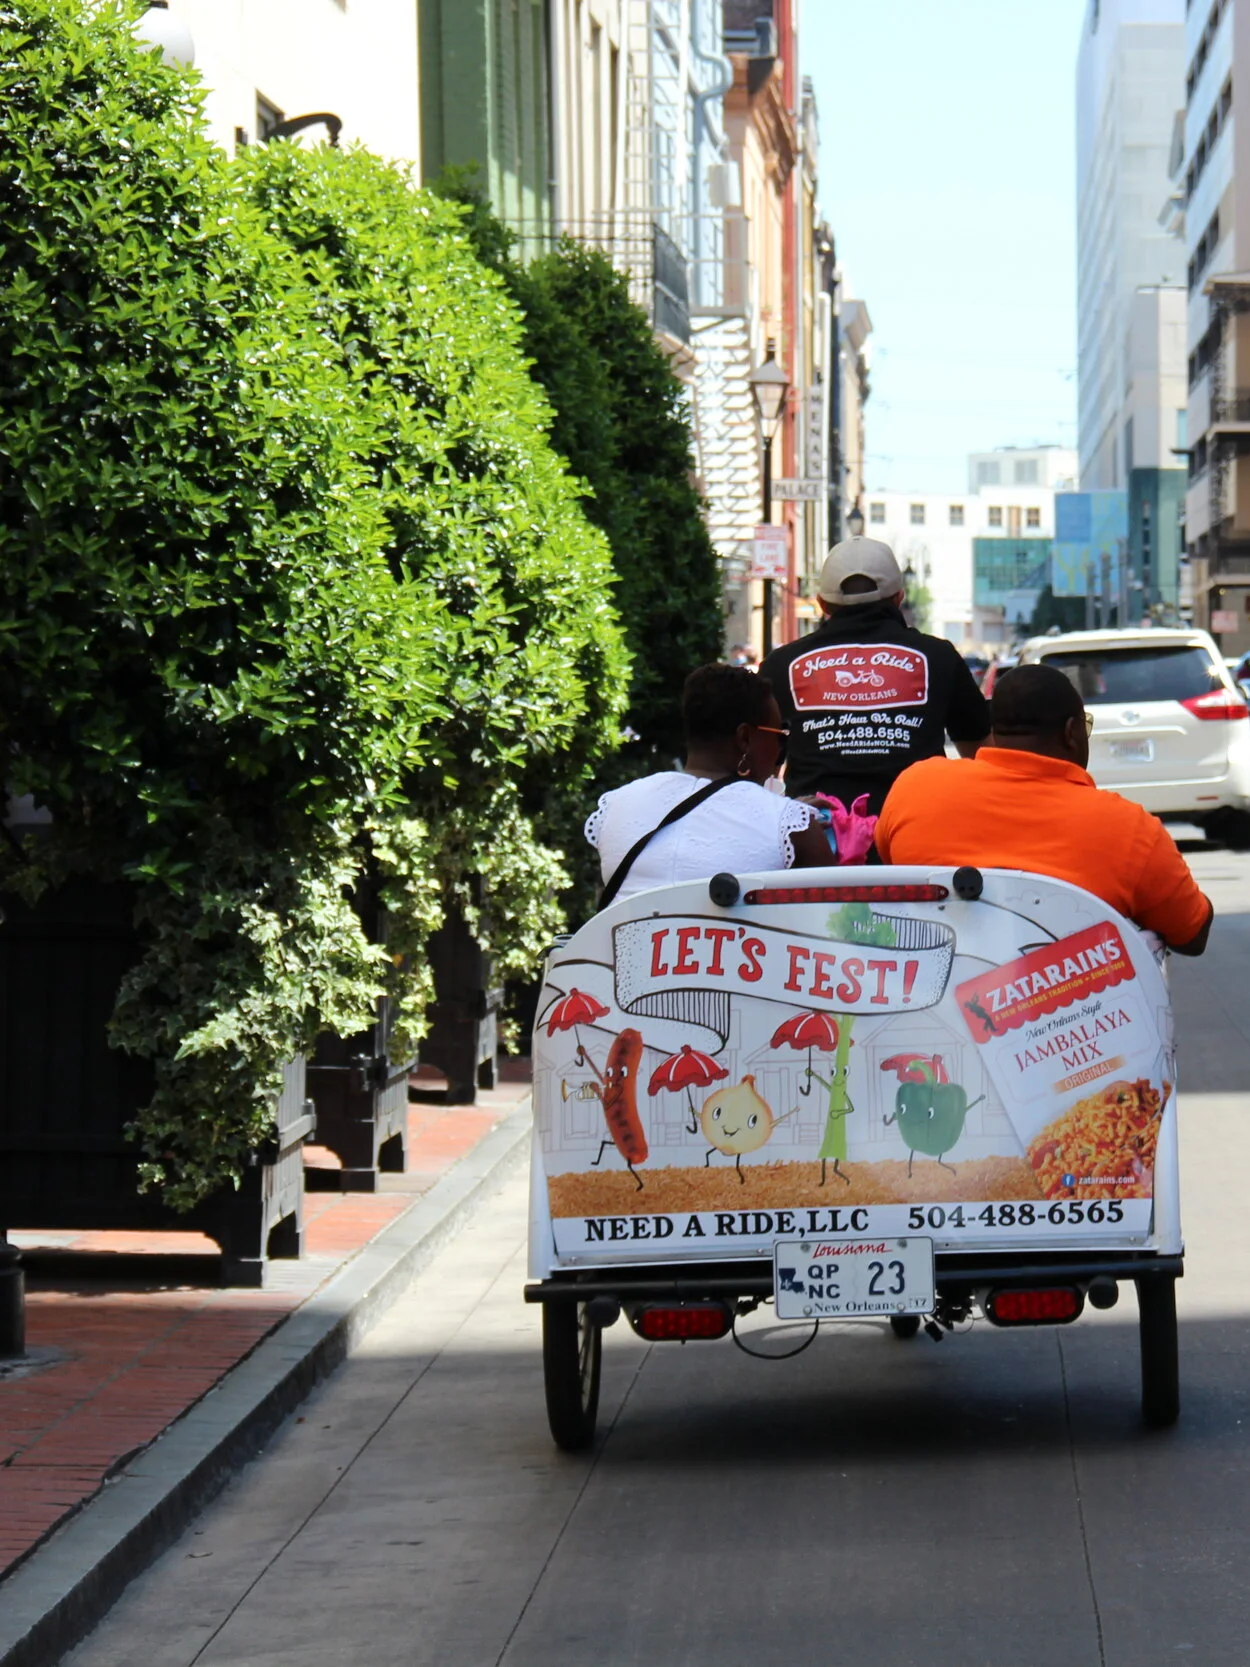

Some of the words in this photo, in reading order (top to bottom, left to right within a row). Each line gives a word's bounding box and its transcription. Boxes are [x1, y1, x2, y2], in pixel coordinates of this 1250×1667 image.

[774, 484, 819, 497] PALACE
[803, 653, 849, 677] Need
[852, 656, 866, 665] a
[870, 652, 915, 672] Ride
[823, 691, 848, 701] NEW
[849, 688, 898, 701] ORLEANS
[802, 716, 835, 733] That's
[838, 713, 868, 726] How
[870, 713, 892, 724] We
[894, 714, 923, 728] Roll!
[818, 727, 910, 744] 504.488.6565
[819, 740, 910, 751] www.NeedARideNOLA.com
[650, 926, 767, 982] LET'S
[784, 945, 919, 1004] FEST!
[986, 938, 1122, 1013] ZATARAIN'S
[1000, 1006, 1017, 1019] NEW
[1017, 994, 1048, 1012] ORLEANS
[1048, 978, 1084, 999] TRADITION
[1025, 1023, 1048, 1042] New
[1047, 1012, 1081, 1033] Orleans
[1081, 1001, 1103, 1023] Style
[1013, 1008, 1132, 1073] JAMBALAYA
[1061, 1041, 1104, 1072] MIX
[1064, 1062, 1116, 1089] ORIGINAL
[1078, 1175, 1136, 1185] zatarains.com
[584, 1215, 674, 1242] NEED
[682, 1214, 706, 1237] A
[908, 1199, 1124, 1230] 504-488-6565
[812, 1241, 893, 1259] Louisiana
[807, 1263, 840, 1281] QP
[867, 1259, 907, 1296] 23
[808, 1283, 841, 1300] NC
[813, 1302, 842, 1313] New
[845, 1300, 898, 1312] Orleans
